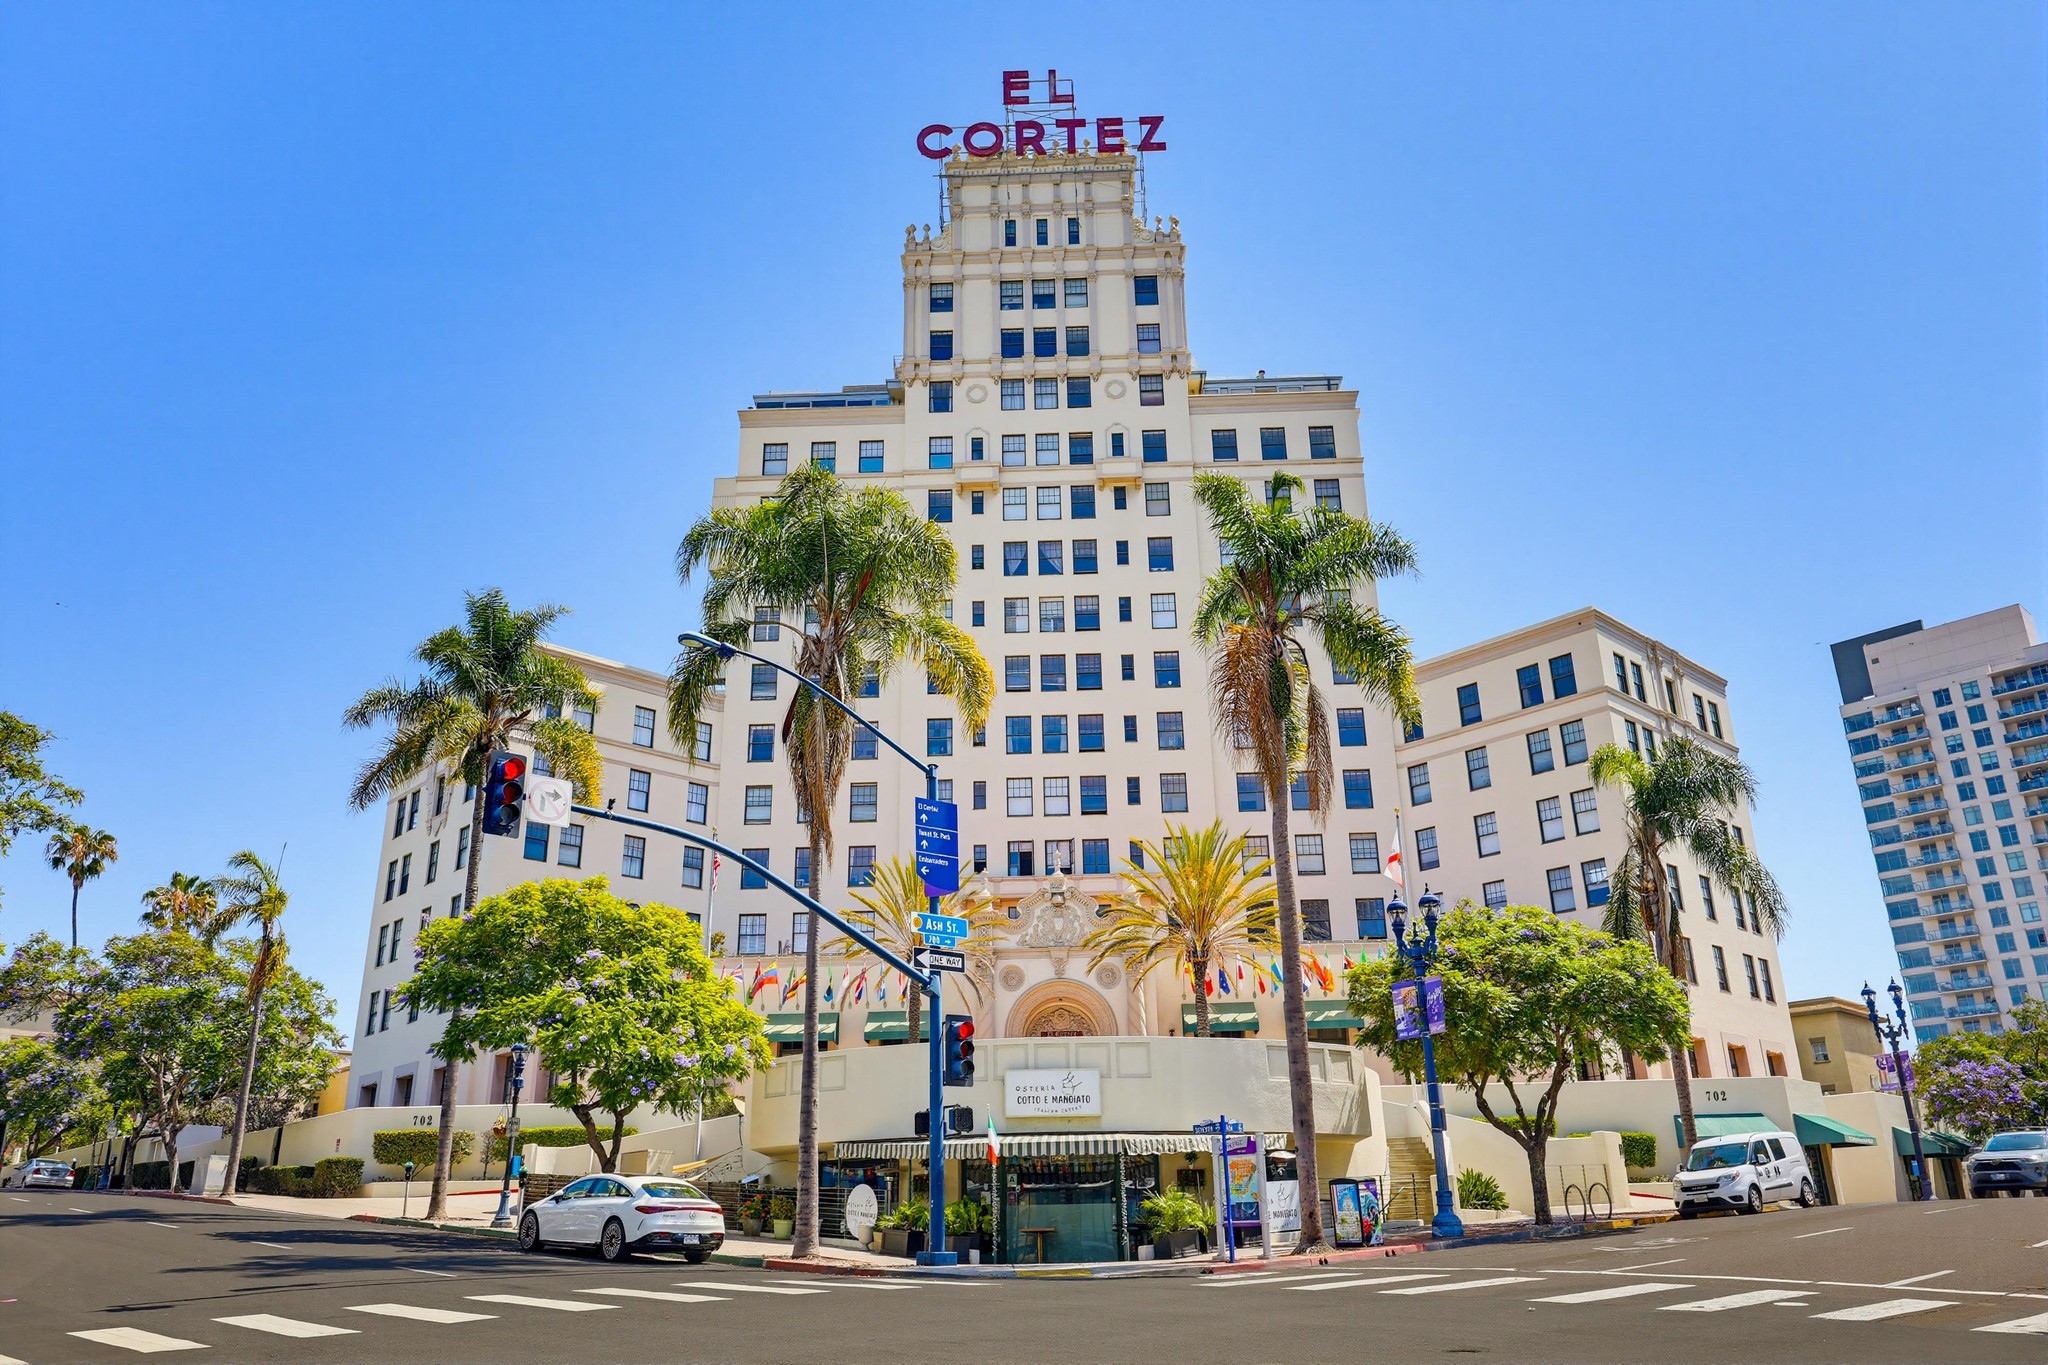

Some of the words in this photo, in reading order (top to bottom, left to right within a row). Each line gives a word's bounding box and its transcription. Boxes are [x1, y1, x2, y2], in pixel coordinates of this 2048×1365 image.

[1003, 69, 1074, 105] EL
[916, 116, 1167, 160] CORTEZ
[930, 955, 944, 965] ONE
[946, 957, 961, 966] WAY
[1015, 1085, 1056, 1093] OSTERIA
[1017, 1095, 1041, 1104] COTTO
[1044, 1095, 1049, 1104] E
[1705, 1090, 1728, 1101] 702
[412, 1115, 433, 1126] 702
